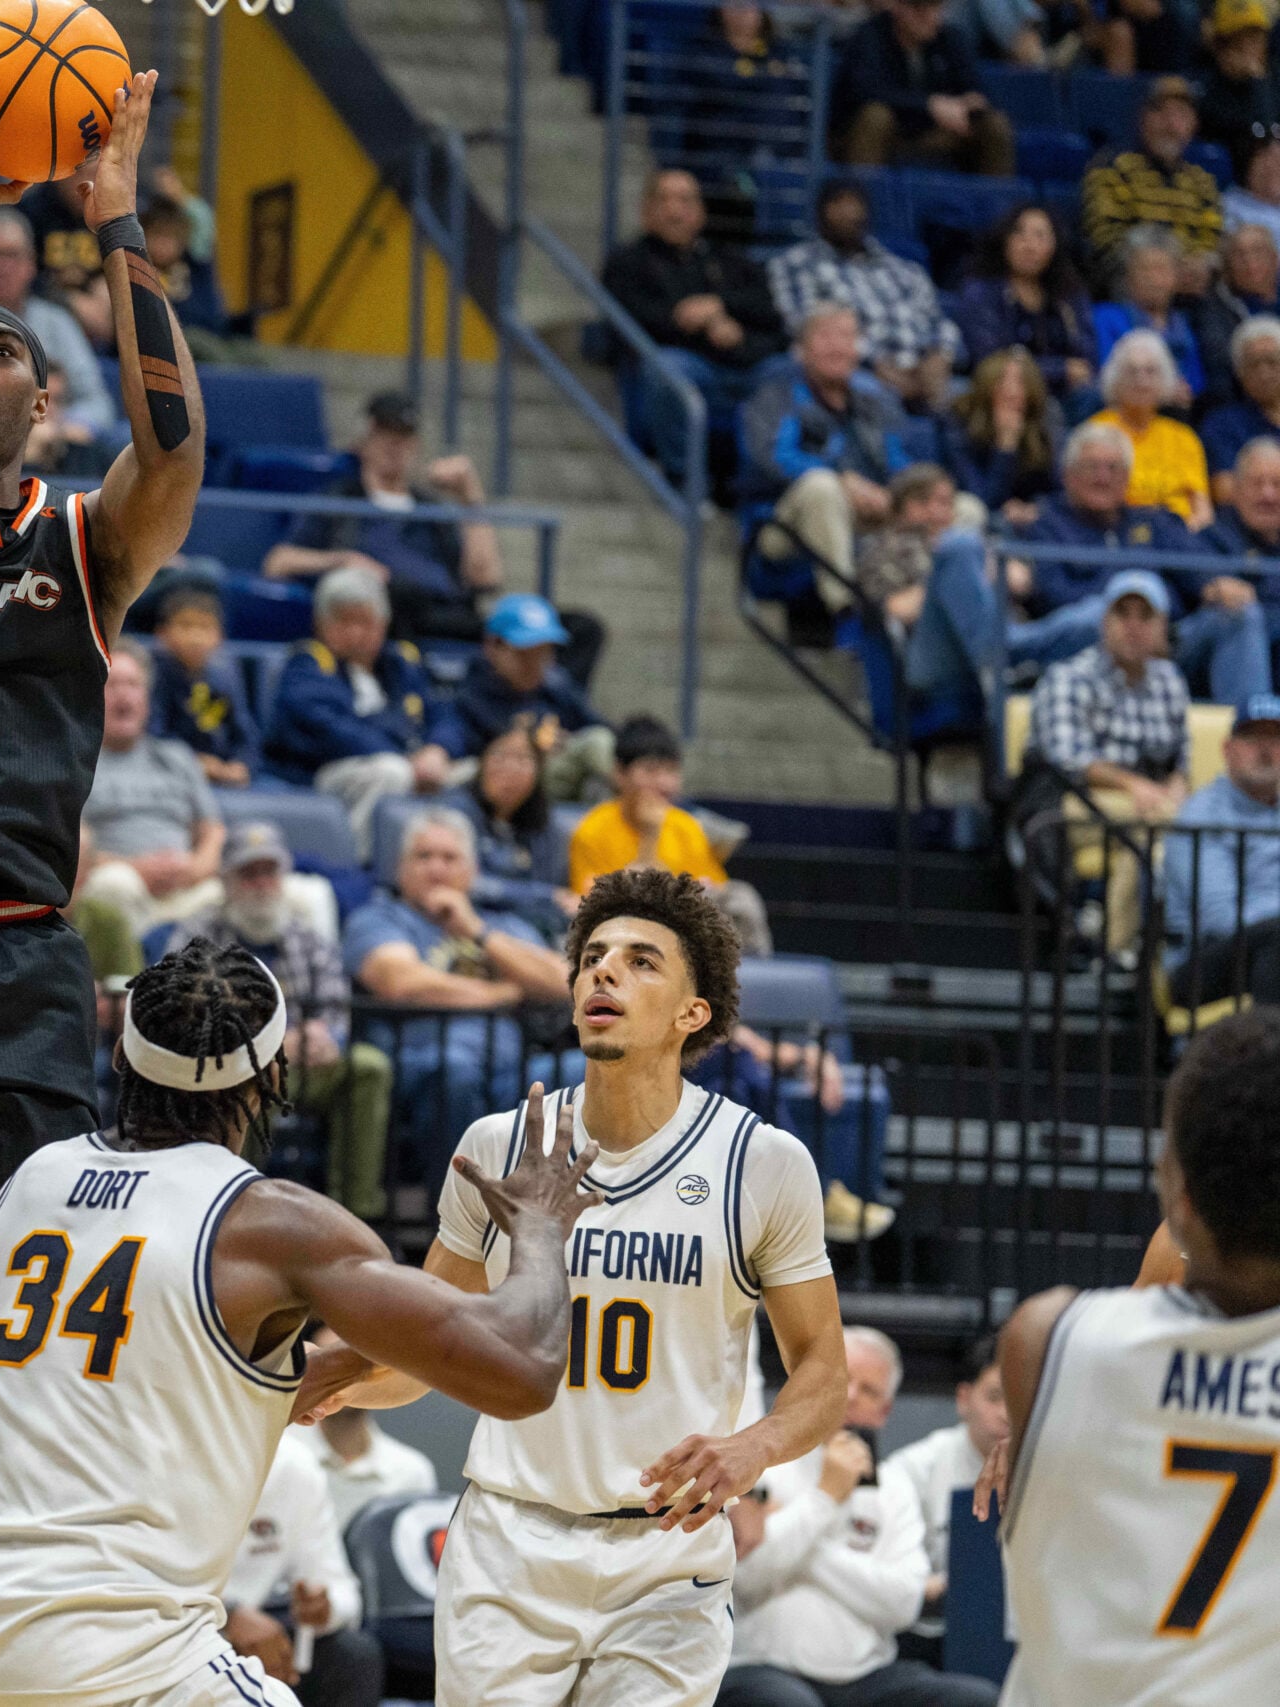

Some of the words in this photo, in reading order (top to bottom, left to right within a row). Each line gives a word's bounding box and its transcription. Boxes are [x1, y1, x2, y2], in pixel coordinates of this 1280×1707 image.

[66, 1168, 150, 1211] DORT
[680, 1183, 709, 1193] ACC
[567, 1227, 703, 1287] IFORNIA
[566, 1294, 654, 1394] 10
[1155, 1435, 1279, 1638] 7
